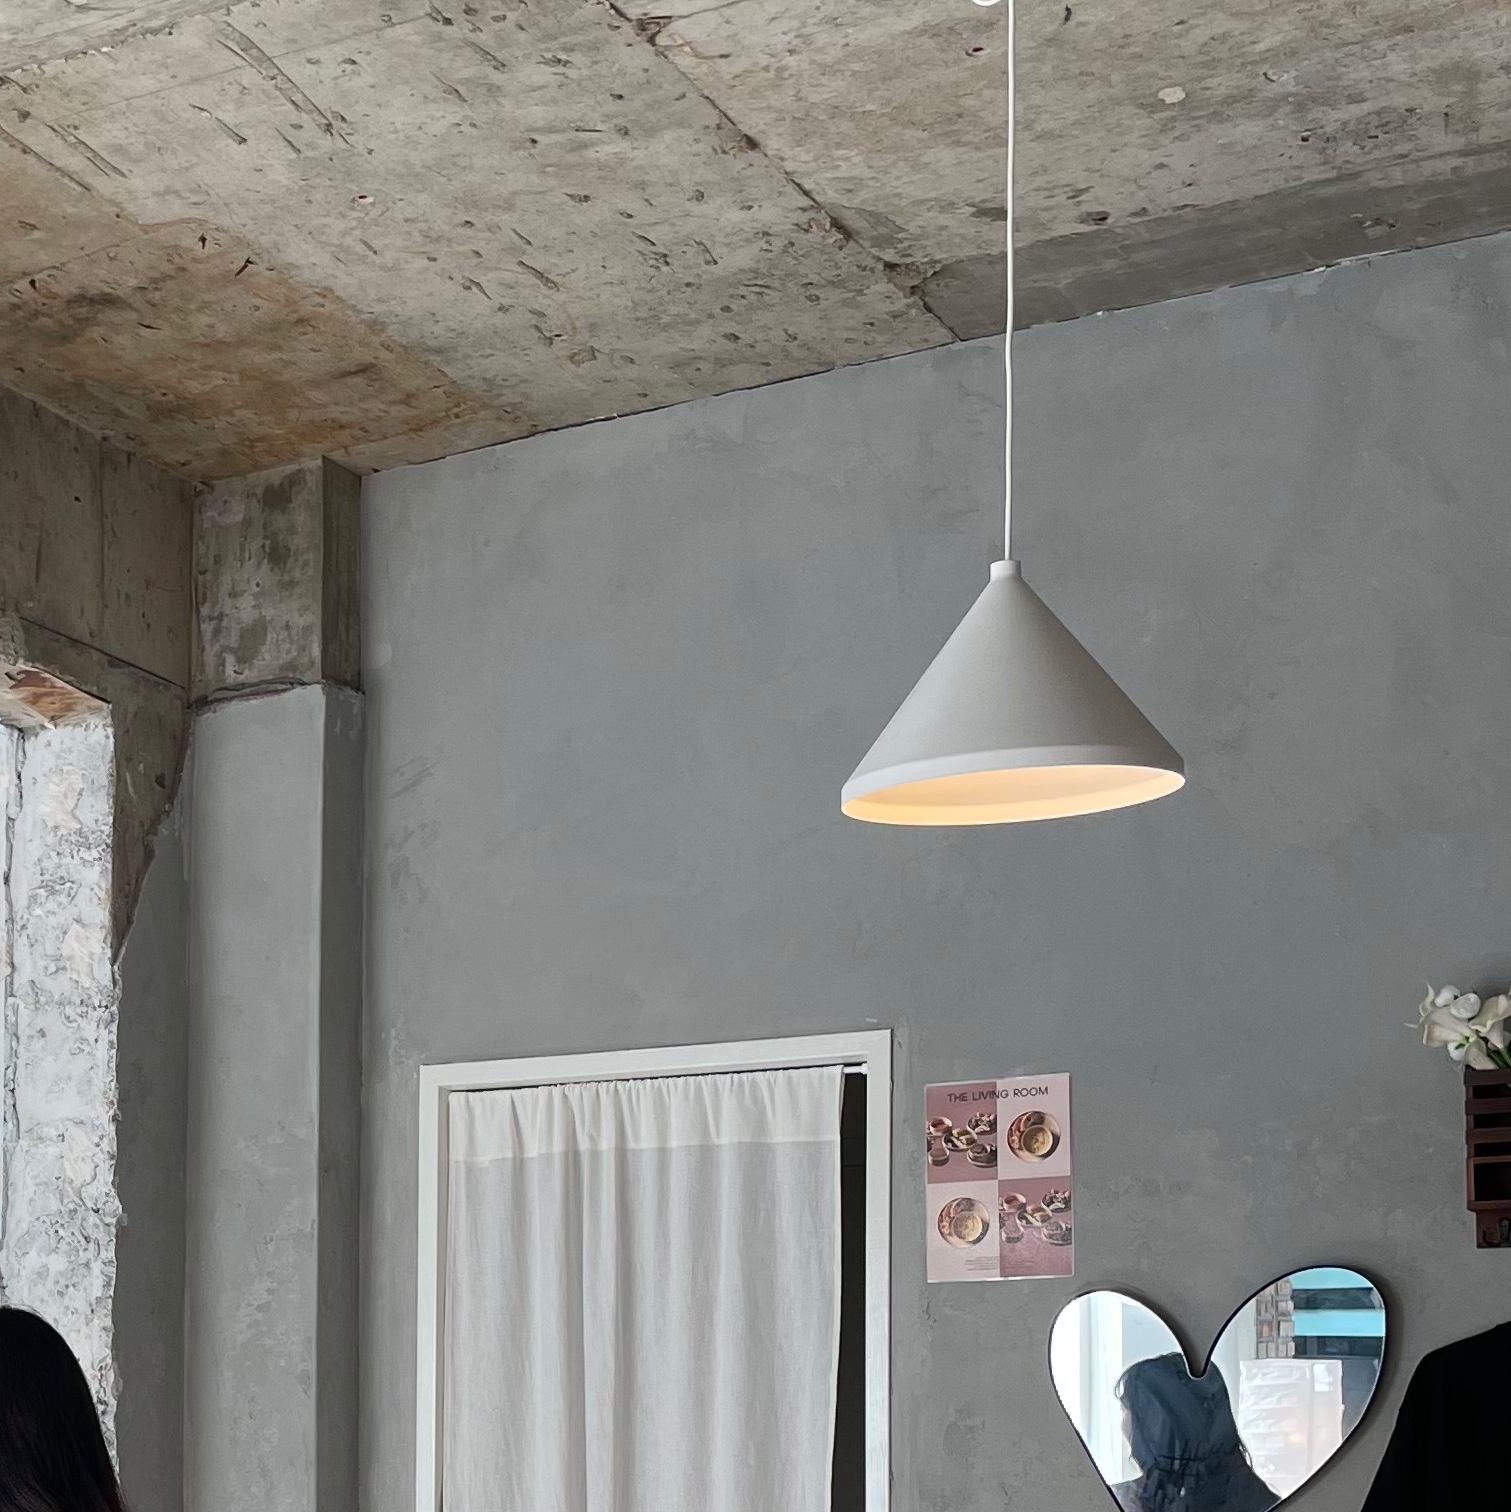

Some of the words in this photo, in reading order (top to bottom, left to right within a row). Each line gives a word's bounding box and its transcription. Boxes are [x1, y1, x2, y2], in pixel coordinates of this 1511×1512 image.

[946, 1092, 968, 1103] THE
[972, 1089, 1009, 1101] LIVING
[1013, 1085, 1049, 1098] ROOM
